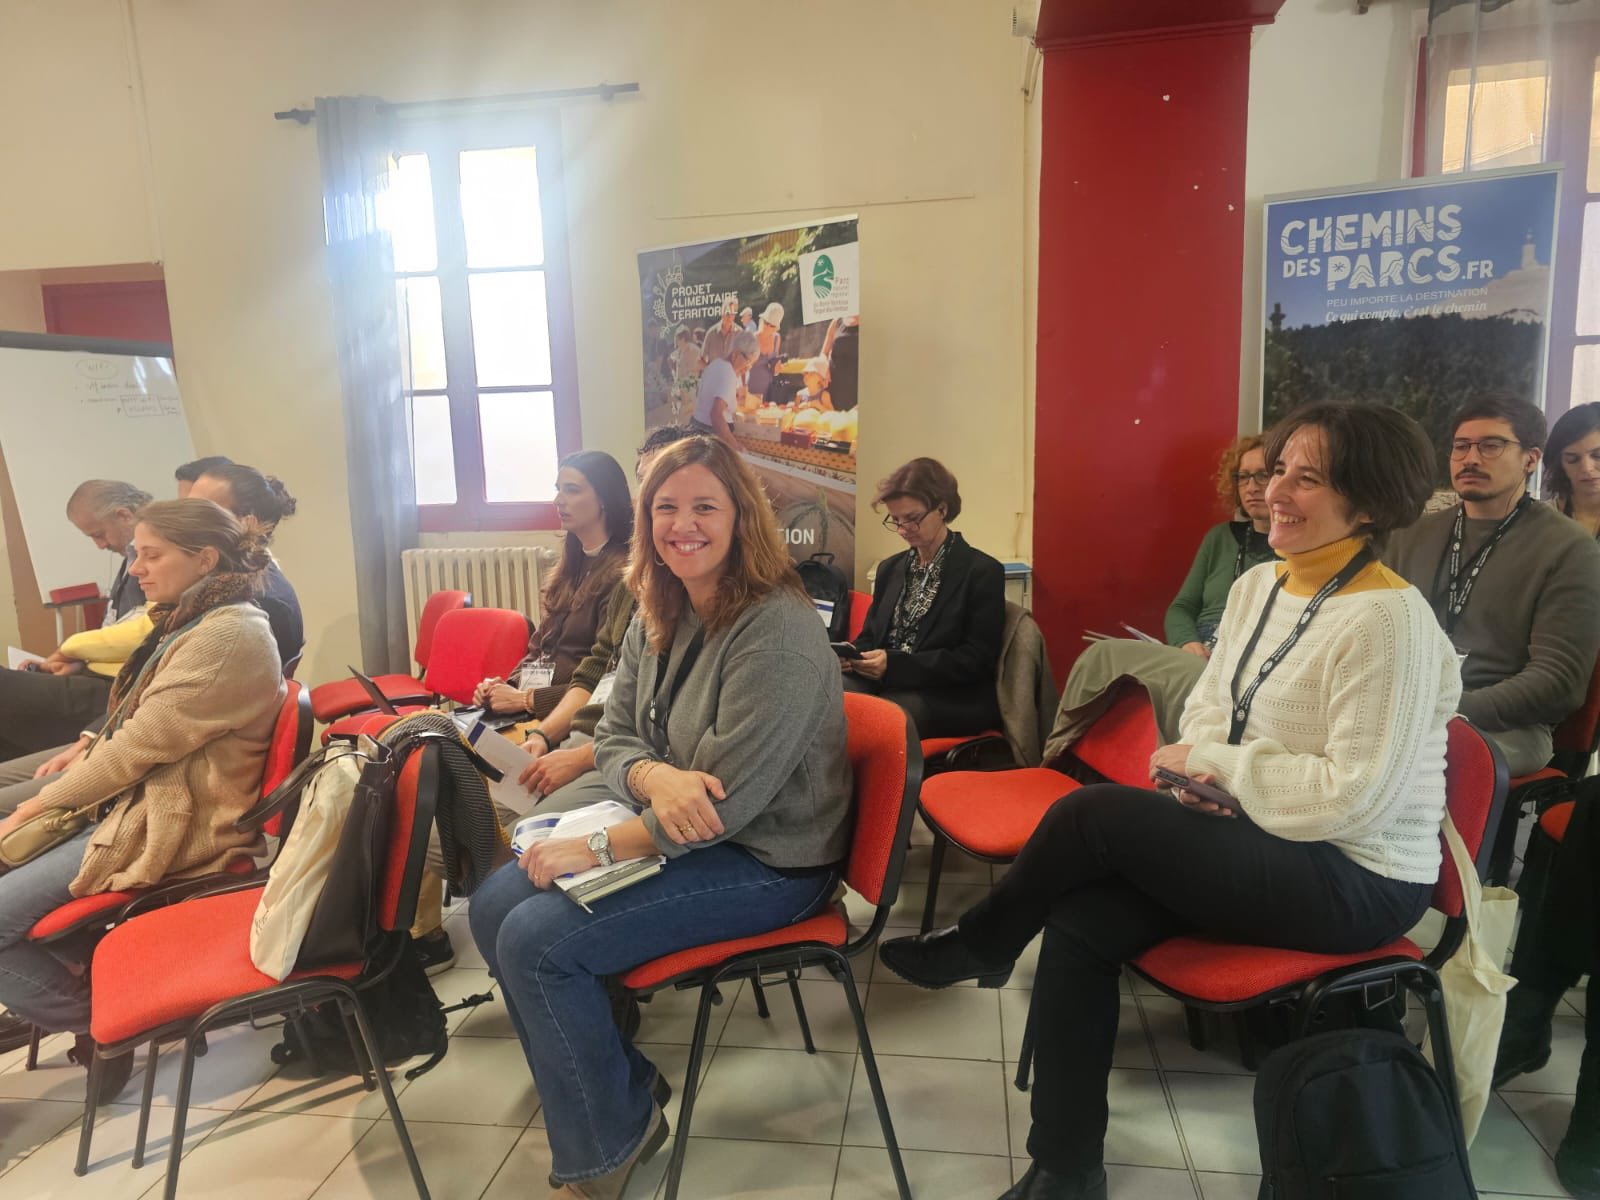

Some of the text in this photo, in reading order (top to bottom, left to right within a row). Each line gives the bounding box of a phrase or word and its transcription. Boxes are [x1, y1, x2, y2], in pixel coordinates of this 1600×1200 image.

[1280, 204, 1463, 256] CHEMINS
[1283, 245, 1494, 291] DES PARCS.FR
[671, 283, 712, 298] PROJET
[671, 291, 738, 309] ALIMENTAIRE
[1327, 287, 1489, 307] PEU IMPORTE LA DESTINATION
[671, 305, 738, 321] TERRITORIAL
[1326, 311, 1339, 322] Ce
[1339, 309, 1359, 324] qui
[1444, 300, 1488, 314] chemin
